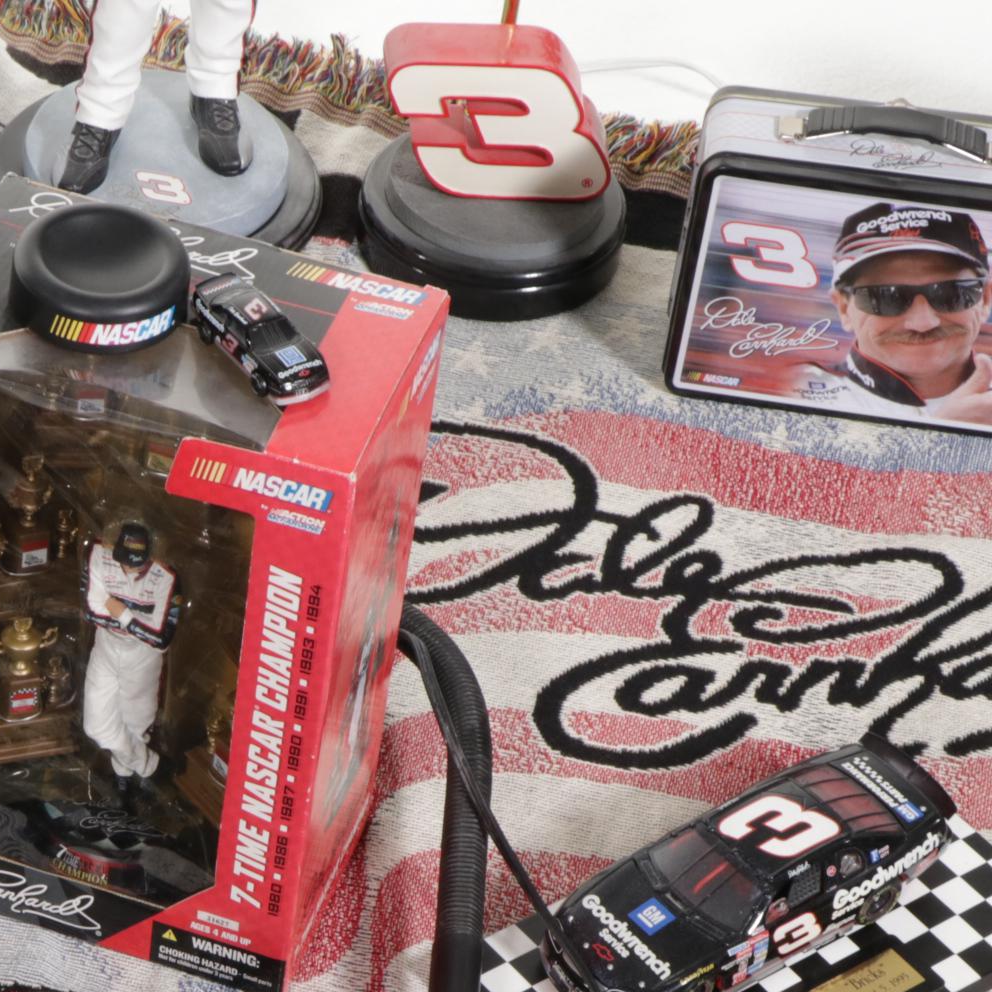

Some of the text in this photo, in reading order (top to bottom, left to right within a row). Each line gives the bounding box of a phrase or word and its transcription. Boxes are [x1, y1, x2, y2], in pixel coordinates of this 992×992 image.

[388, 61, 611, 200] 3
[136, 171, 192, 205] 3
[856, 208, 953, 233] Goodwrench
[880, 218, 929, 233] Service
[721, 220, 820, 289] 3
[326, 271, 425, 306] NASCAR
[90, 304, 176, 346] NASCAR
[244, 297, 268, 320] 3
[221, 333, 240, 354] 3
[702, 373, 740, 387] NASCAR
[233, 467, 328, 512] NASCAR
[255, 565, 304, 714] CHAMPION
[240, 713, 285, 822] NASCAR
[267, 583, 322, 918] 1980 1986 1987 1990 1991 1993 1994
[717, 795, 842, 859] 3
[52, 857, 109, 886] CHAMPION
[230, 819, 271, 909] 7-TIME
[832, 831, 940, 909] Goodwrench
[641, 903, 668, 927] GM
[190, 921, 252, 946] AGES 4 AND UP
[581, 894, 672, 981] Goodwrench
[598, 928, 631, 959] Service
[772, 911, 822, 956] 3
[159, 945, 201, 964] CHOKING
[201, 957, 239, 976] HAZARD
[191, 936, 261, 968] WARNING:
